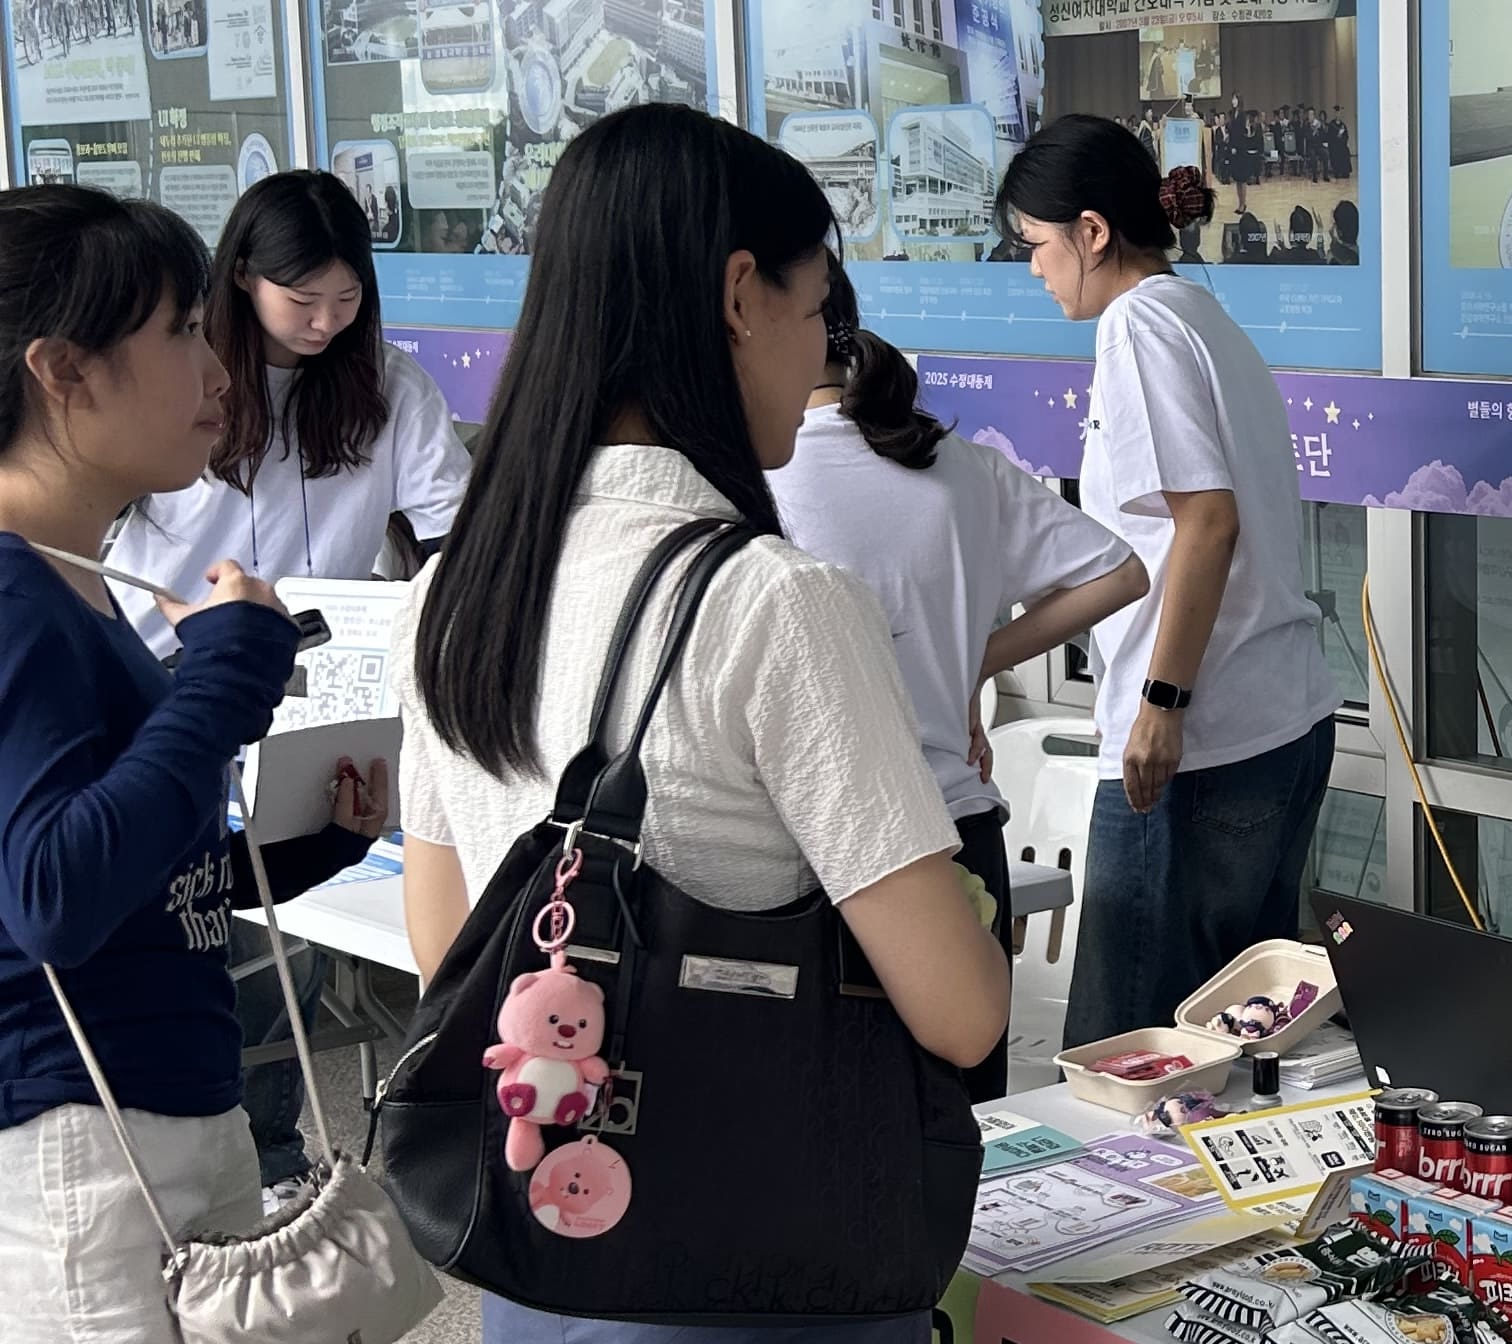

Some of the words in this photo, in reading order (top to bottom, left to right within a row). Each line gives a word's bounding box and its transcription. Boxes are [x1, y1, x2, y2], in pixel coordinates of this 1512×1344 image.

[925, 372, 948, 385] 2025
[949, 373, 993, 389] 수정대동제
[1467, 401, 1502, 421] 별들의
[1479, 1144, 1507, 1153] SUGAR
